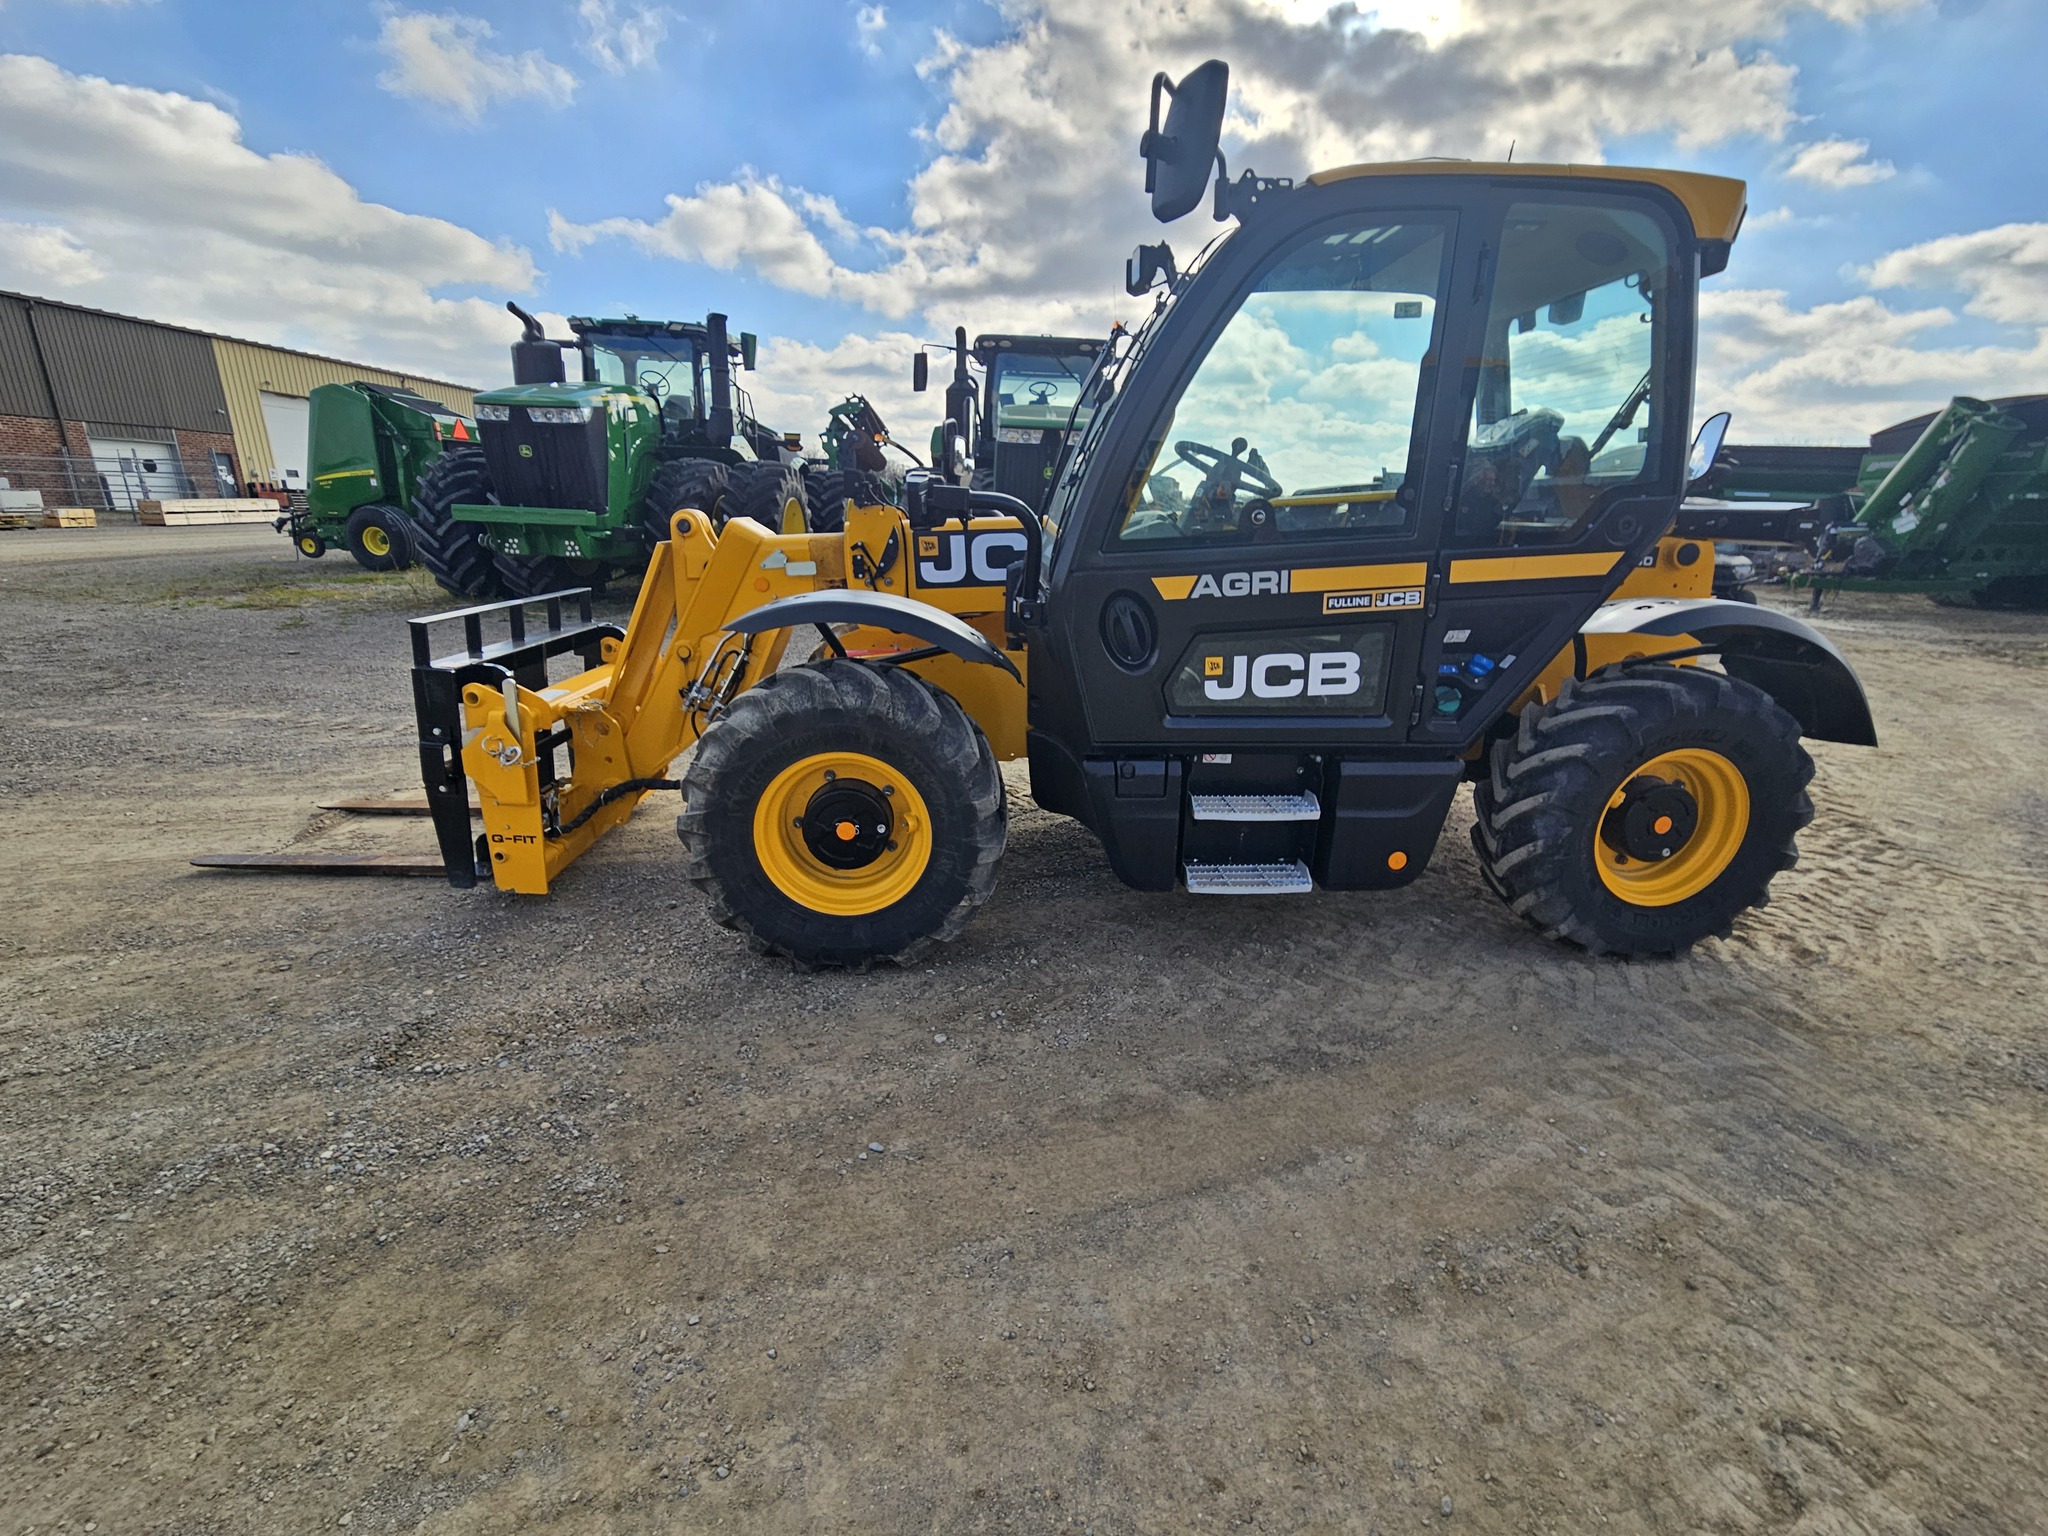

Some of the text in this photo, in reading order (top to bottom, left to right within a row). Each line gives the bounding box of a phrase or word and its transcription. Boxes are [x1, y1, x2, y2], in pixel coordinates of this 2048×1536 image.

[920, 532, 1028, 583] JC
[1638, 555, 1654, 567] 0
[1191, 570, 1289, 599] AGRI
[1328, 591, 1420, 608] FULLINE JCB
[1204, 651, 1361, 700] JCB
[491, 834, 537, 845] Q-FIT
